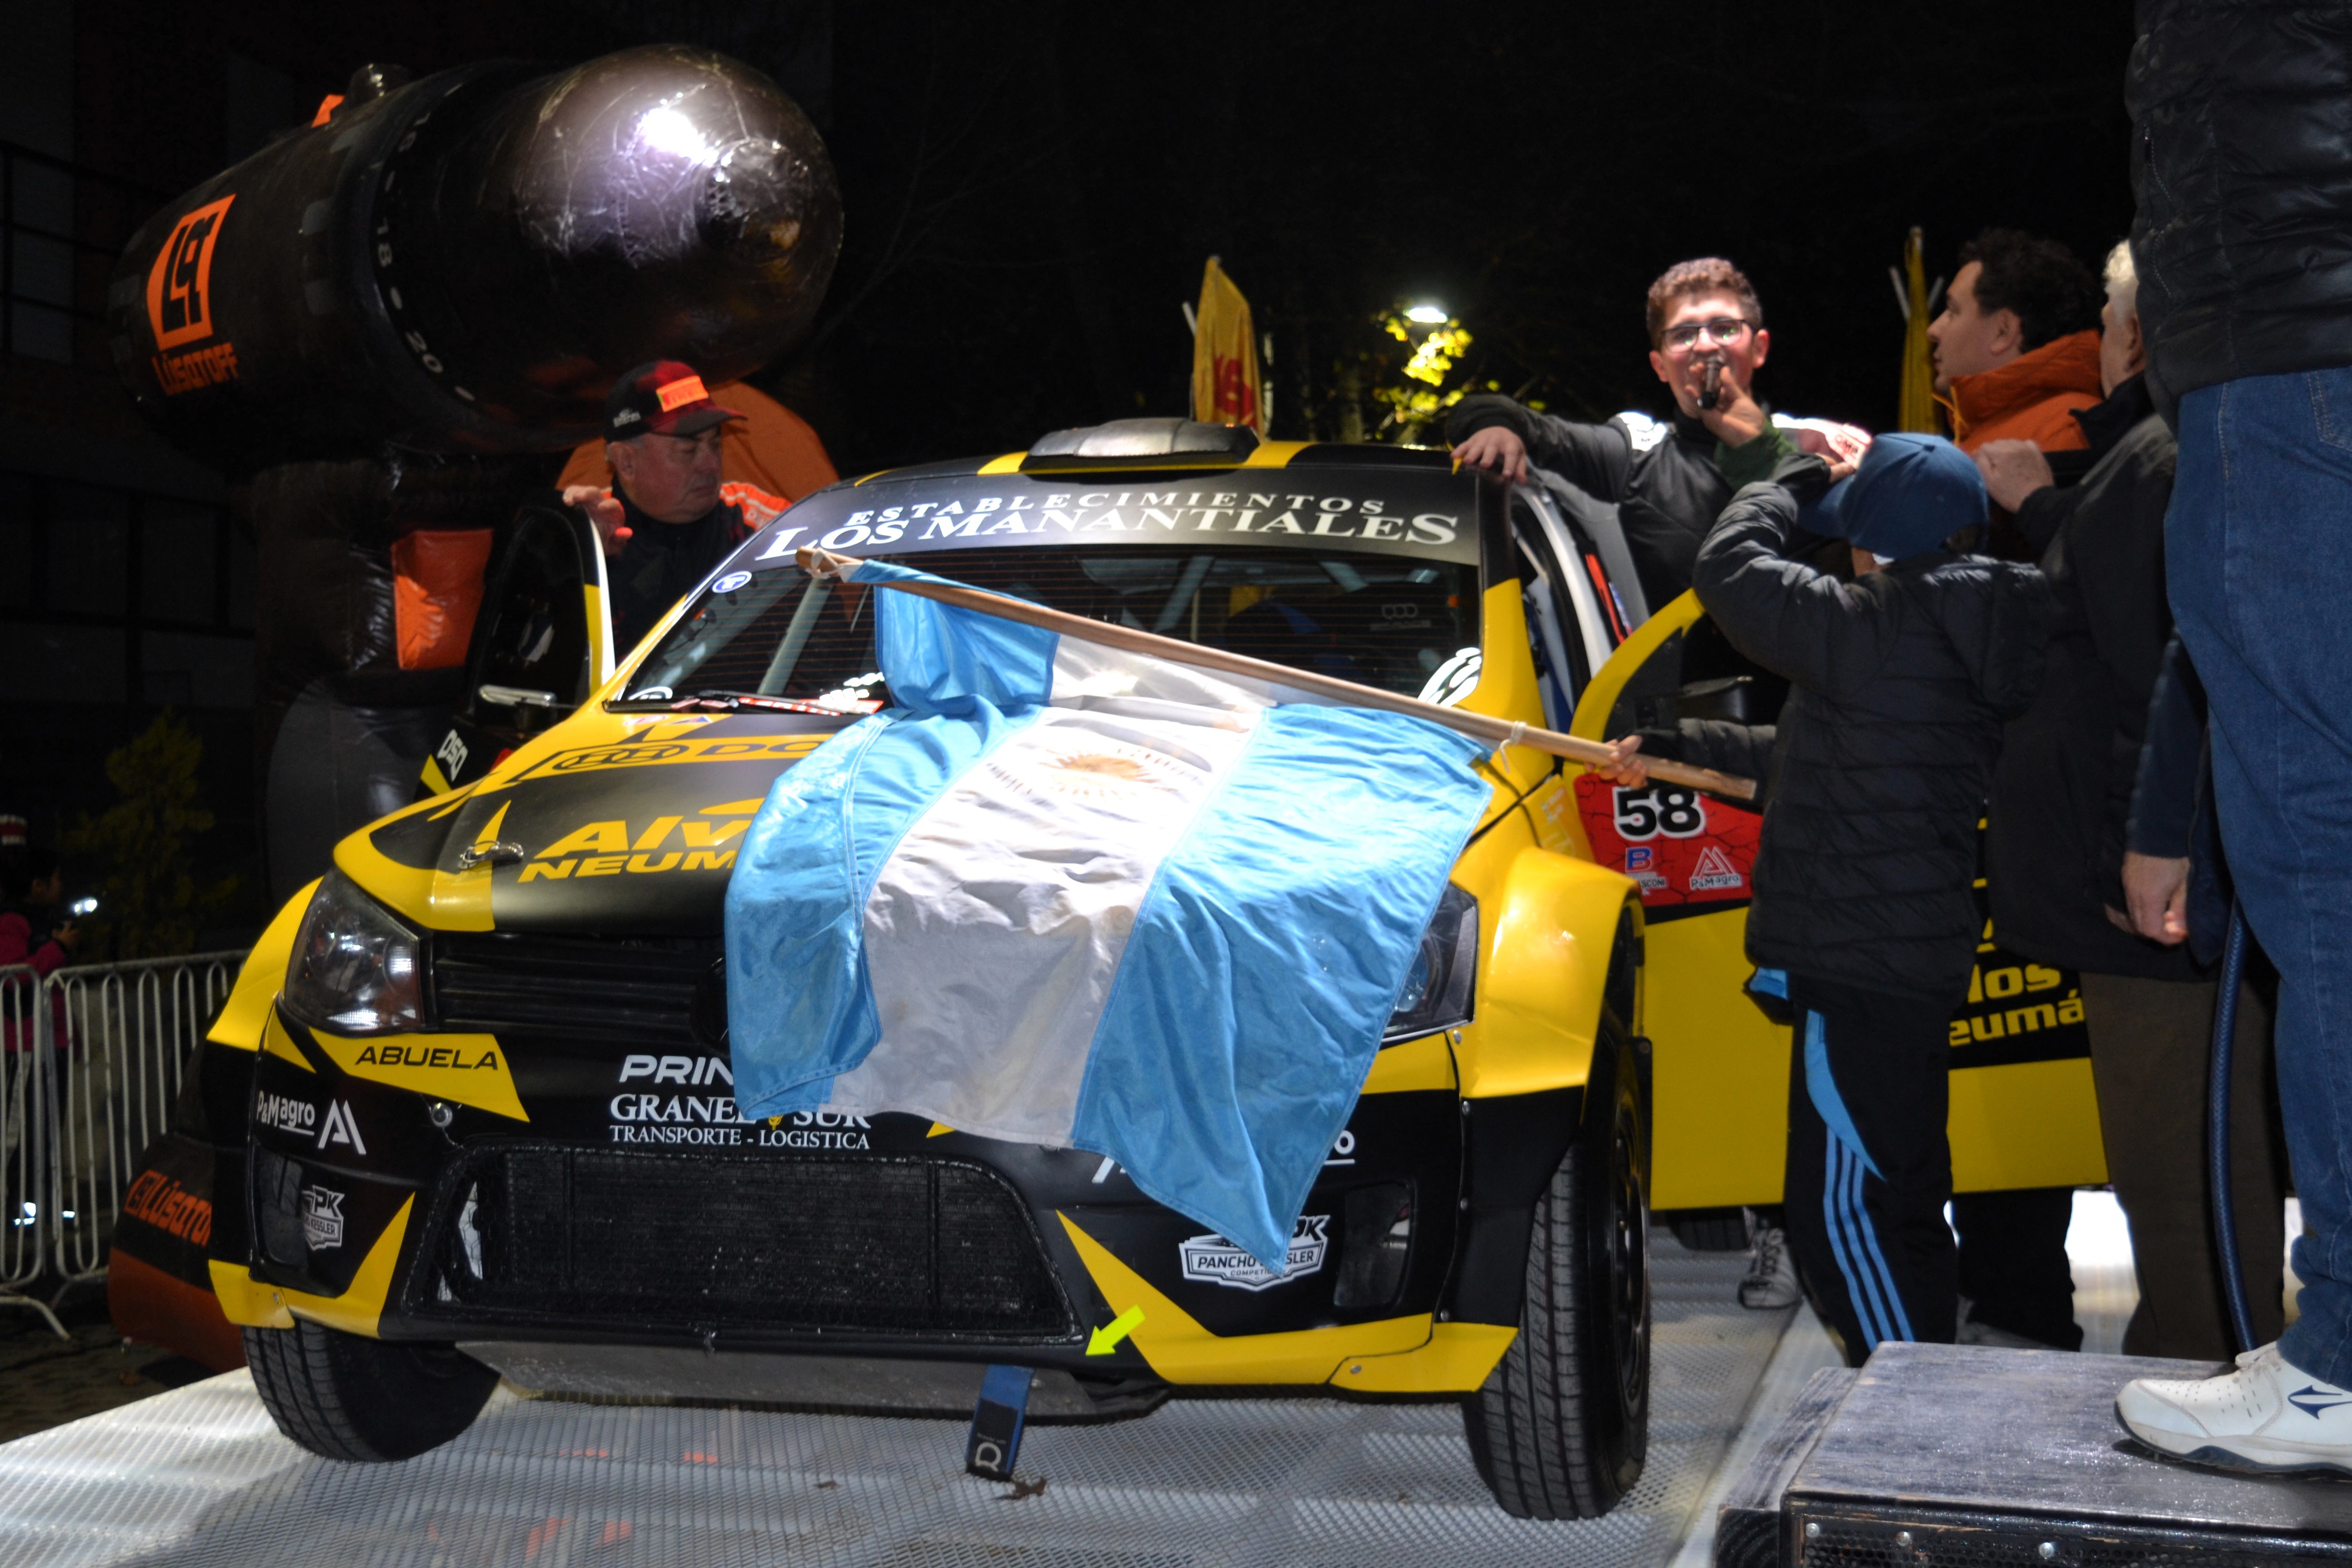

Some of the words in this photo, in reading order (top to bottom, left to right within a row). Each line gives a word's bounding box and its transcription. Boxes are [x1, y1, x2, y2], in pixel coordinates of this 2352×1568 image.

[843, 492, 1385, 527] ESTABLECIMIENTOS
[755, 520, 908, 560] LOS
[919, 508, 1458, 545] MANANTIALES
[1616, 789, 1702, 837] 58
[517, 850, 739, 883] NEUM
[1949, 988, 2086, 1048] eumá
[355, 1046, 498, 1070] ABUELA
[619, 1055, 733, 1085] PRIN
[609, 1125, 741, 1146] TRANSPORTE
[760, 1130, 870, 1149] LOGISTICA
[1197, 1255, 1256, 1268] PANCHO
